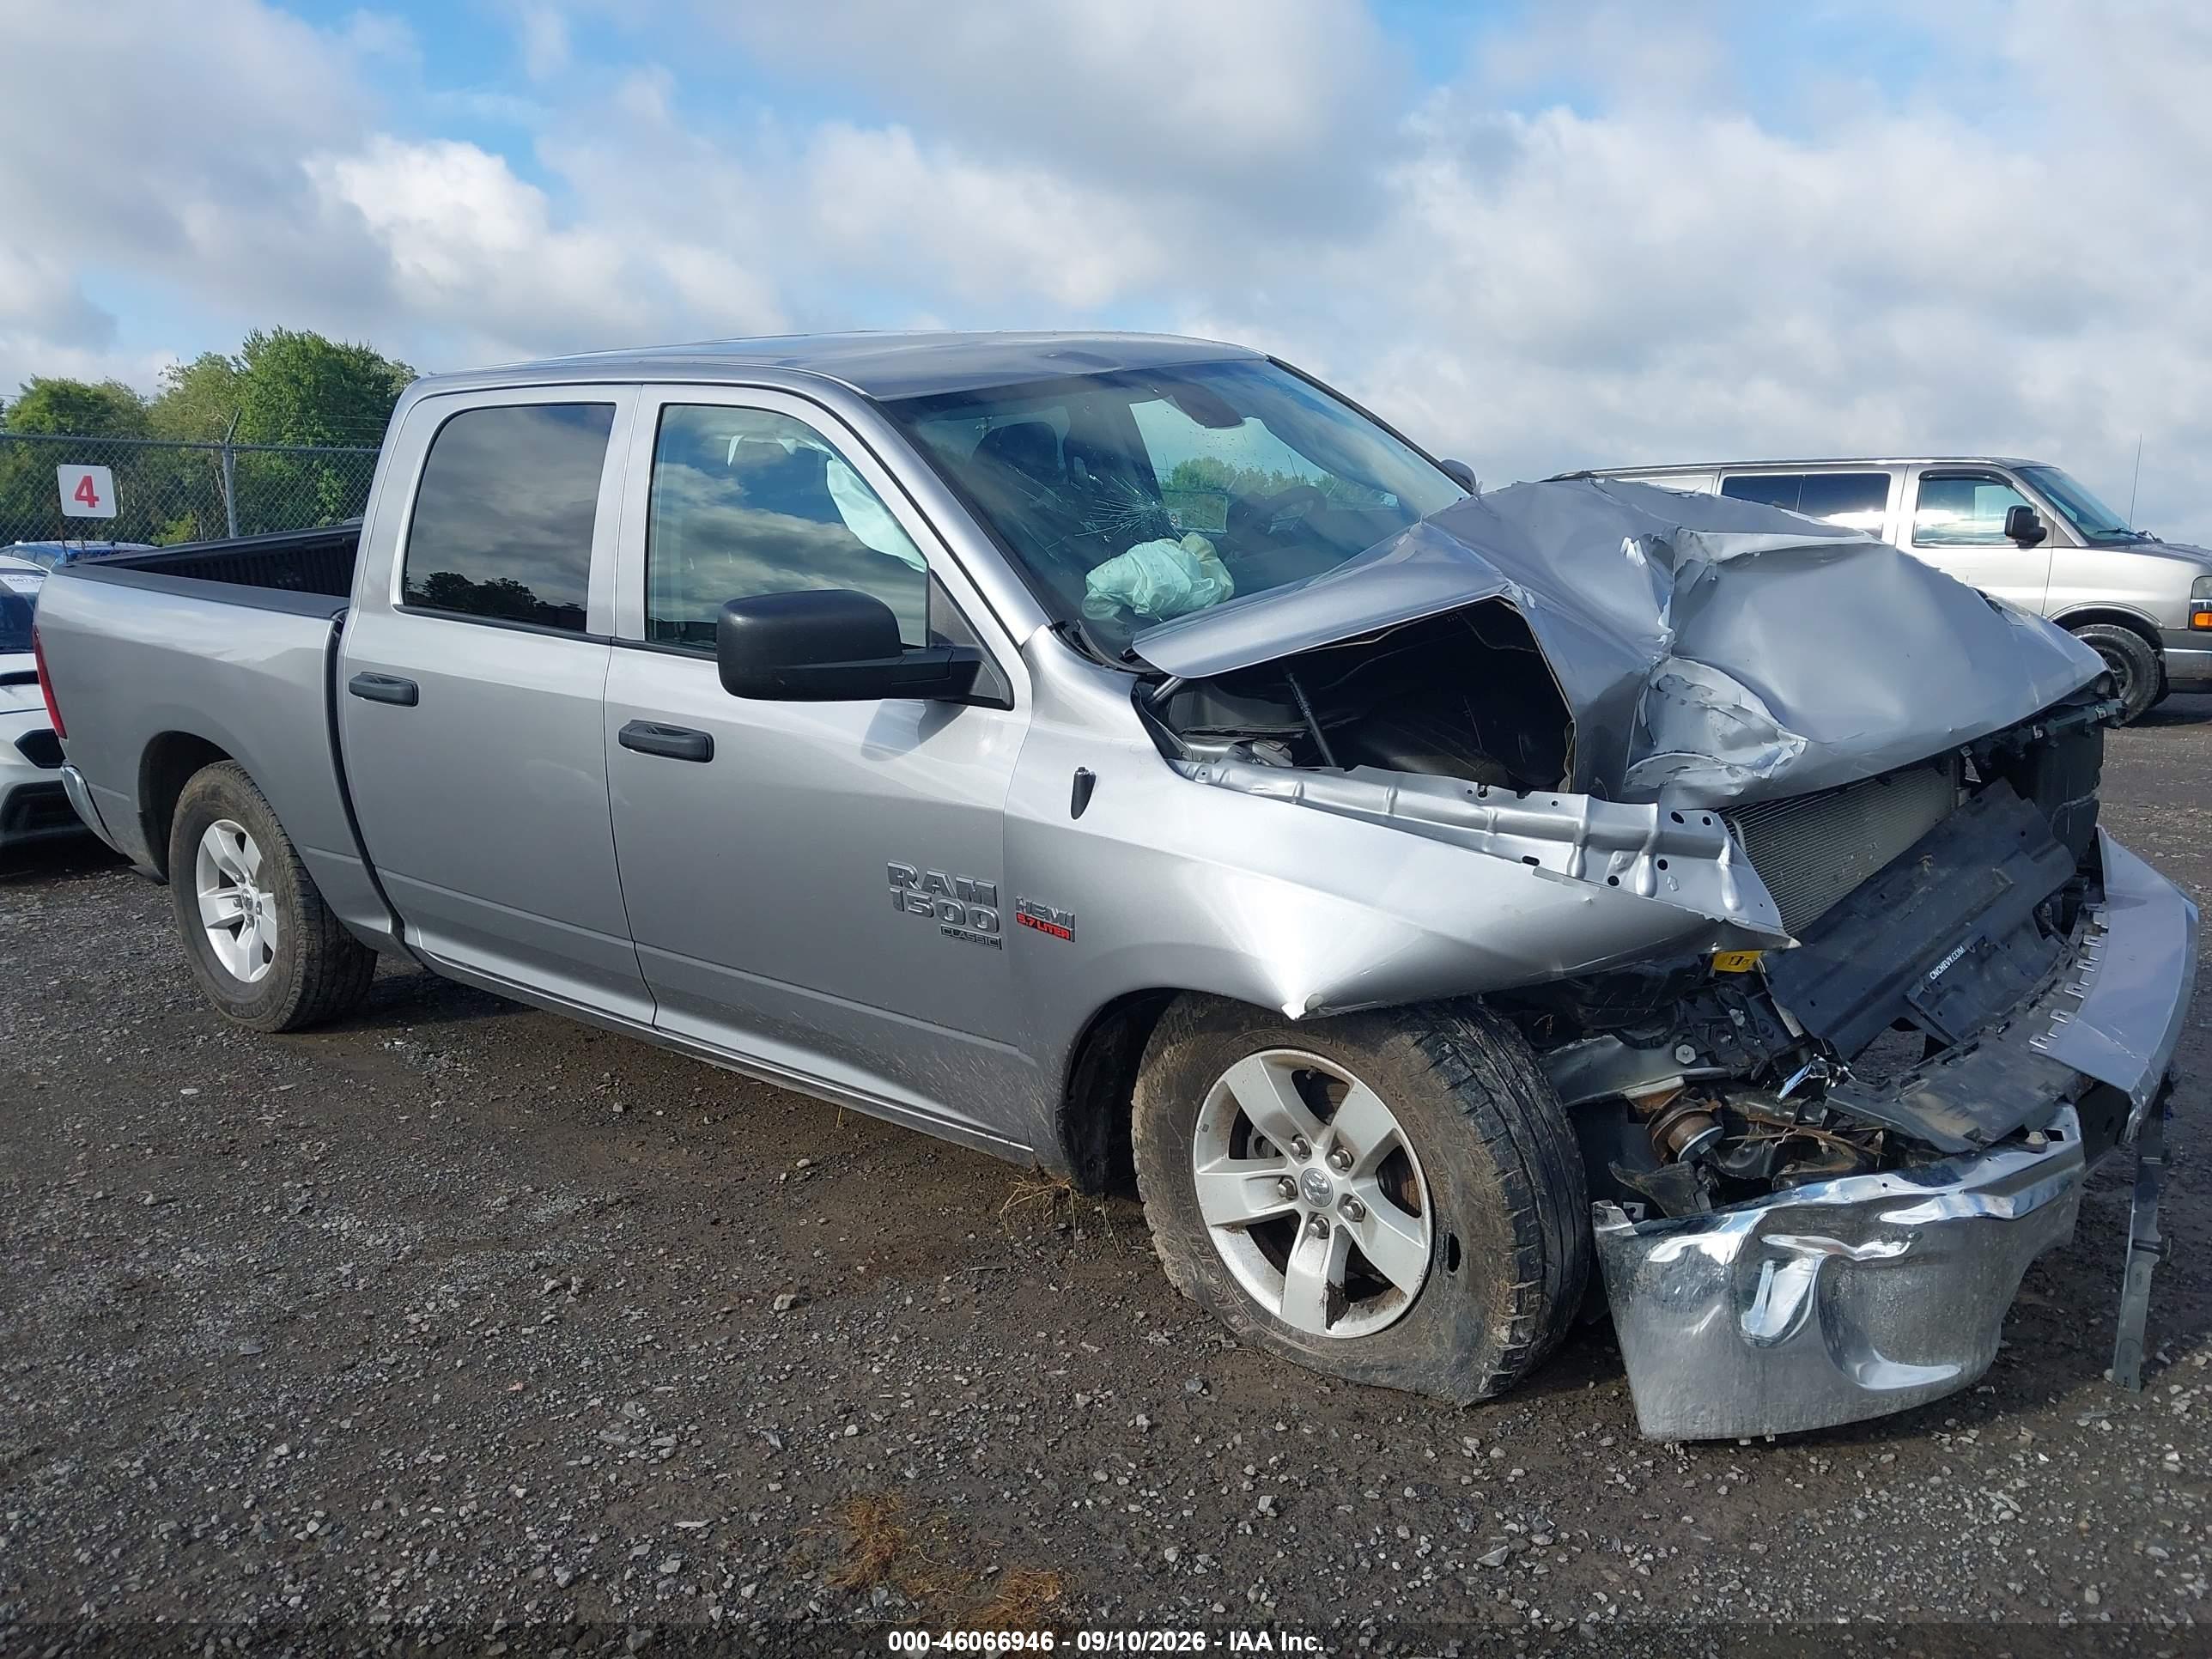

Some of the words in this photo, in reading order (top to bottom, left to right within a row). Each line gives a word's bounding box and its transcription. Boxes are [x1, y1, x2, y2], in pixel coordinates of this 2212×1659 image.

[74, 475, 100, 508] 4
[887, 860, 998, 908] RAM
[889, 887, 1000, 933] 1500
[1016, 895, 1077, 927] HEMI
[941, 926, 1000, 950] CLASSIC
[1017, 913, 1036, 927] 5.7
[1036, 921, 1071, 941] LITER
